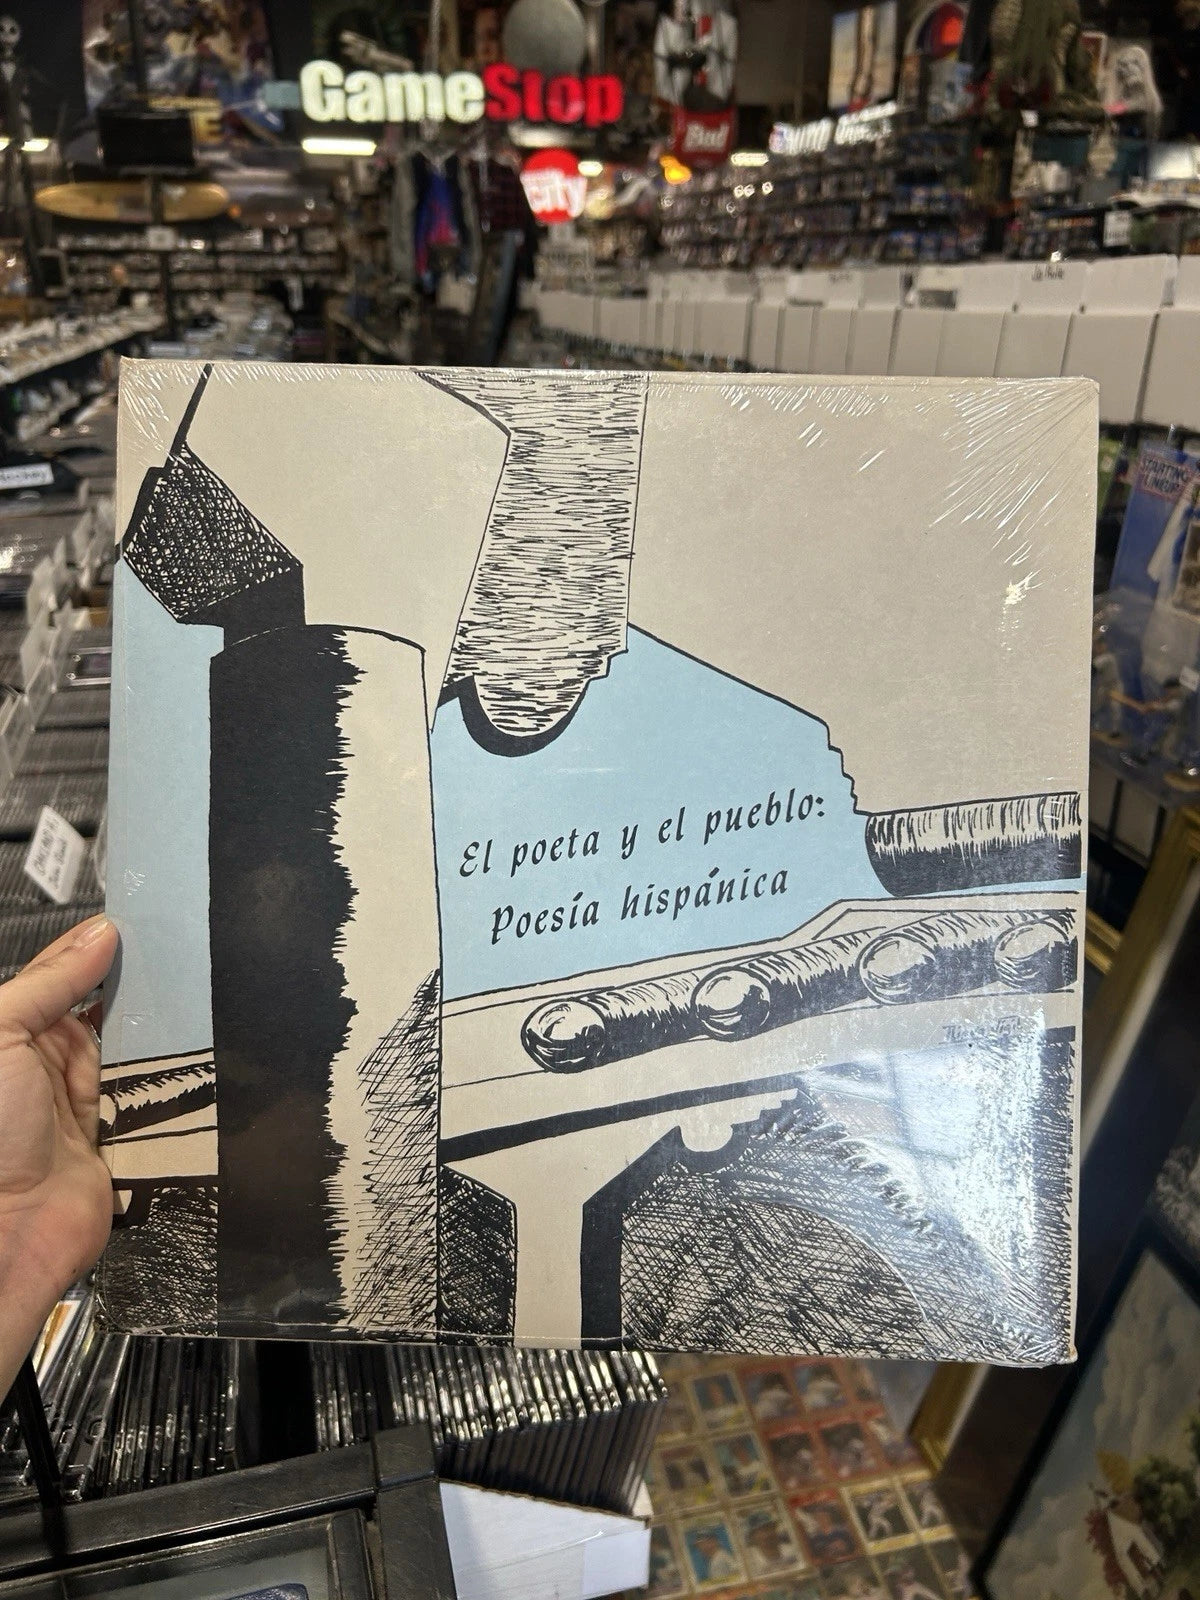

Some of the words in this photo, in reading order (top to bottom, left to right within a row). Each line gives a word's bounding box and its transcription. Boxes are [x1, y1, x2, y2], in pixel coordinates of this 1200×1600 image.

[300, 60, 624, 128] GameStop
[459, 840, 492, 877] El
[510, 827, 600, 876] poeta
[620, 823, 639, 860] y
[658, 807, 686, 844] el
[703, 788, 825, 845] pueblo:
[491, 891, 600, 945] Poesía
[620, 867, 789, 920] hispánica
